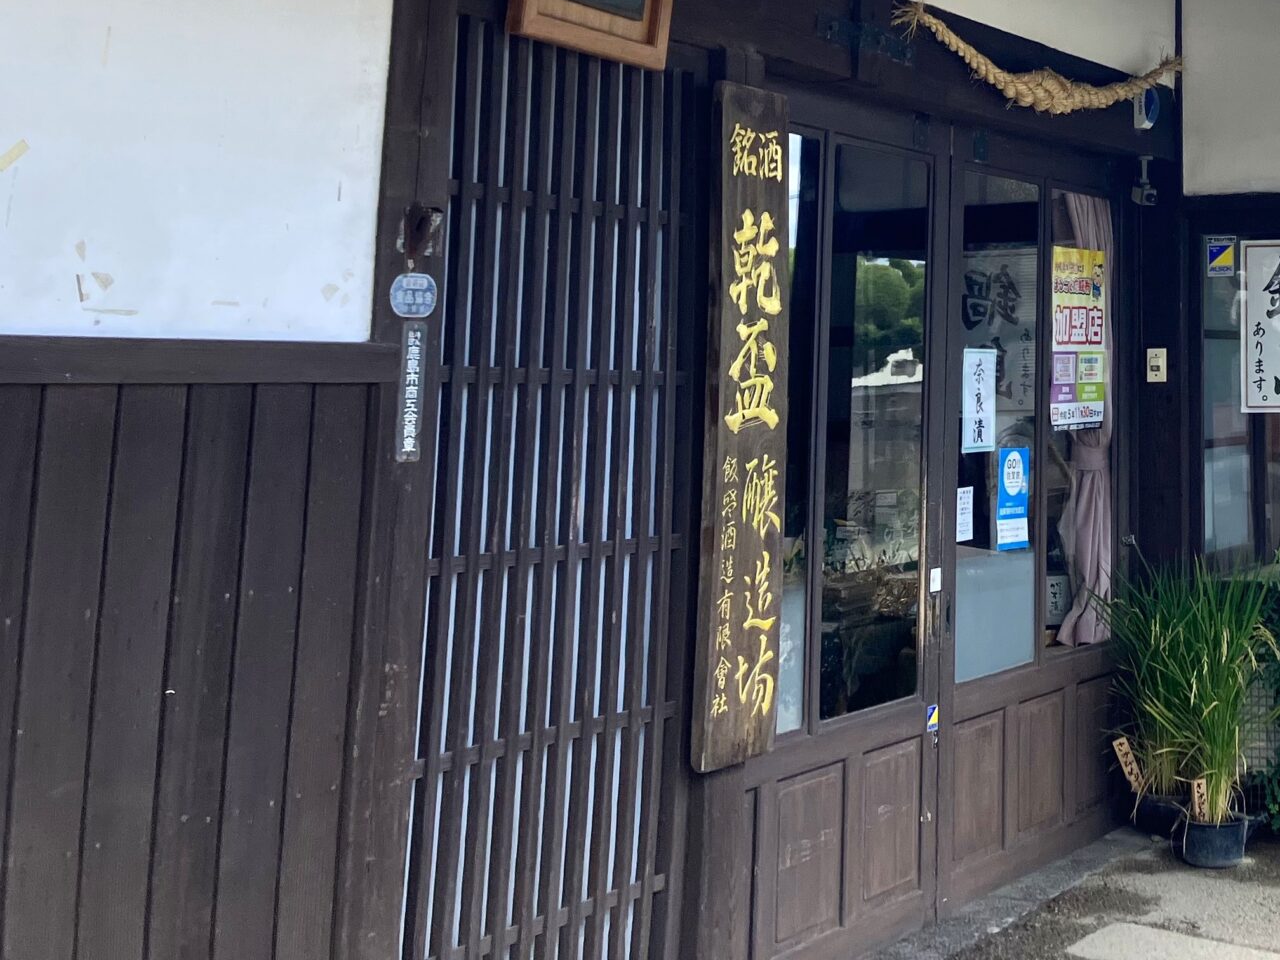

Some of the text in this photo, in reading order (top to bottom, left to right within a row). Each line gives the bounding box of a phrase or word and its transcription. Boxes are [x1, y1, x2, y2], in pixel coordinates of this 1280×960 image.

[730, 122, 783, 183] 銘酒
[1055, 304, 1103, 345] 加盟店
[1252, 321, 1269, 402] あります。
